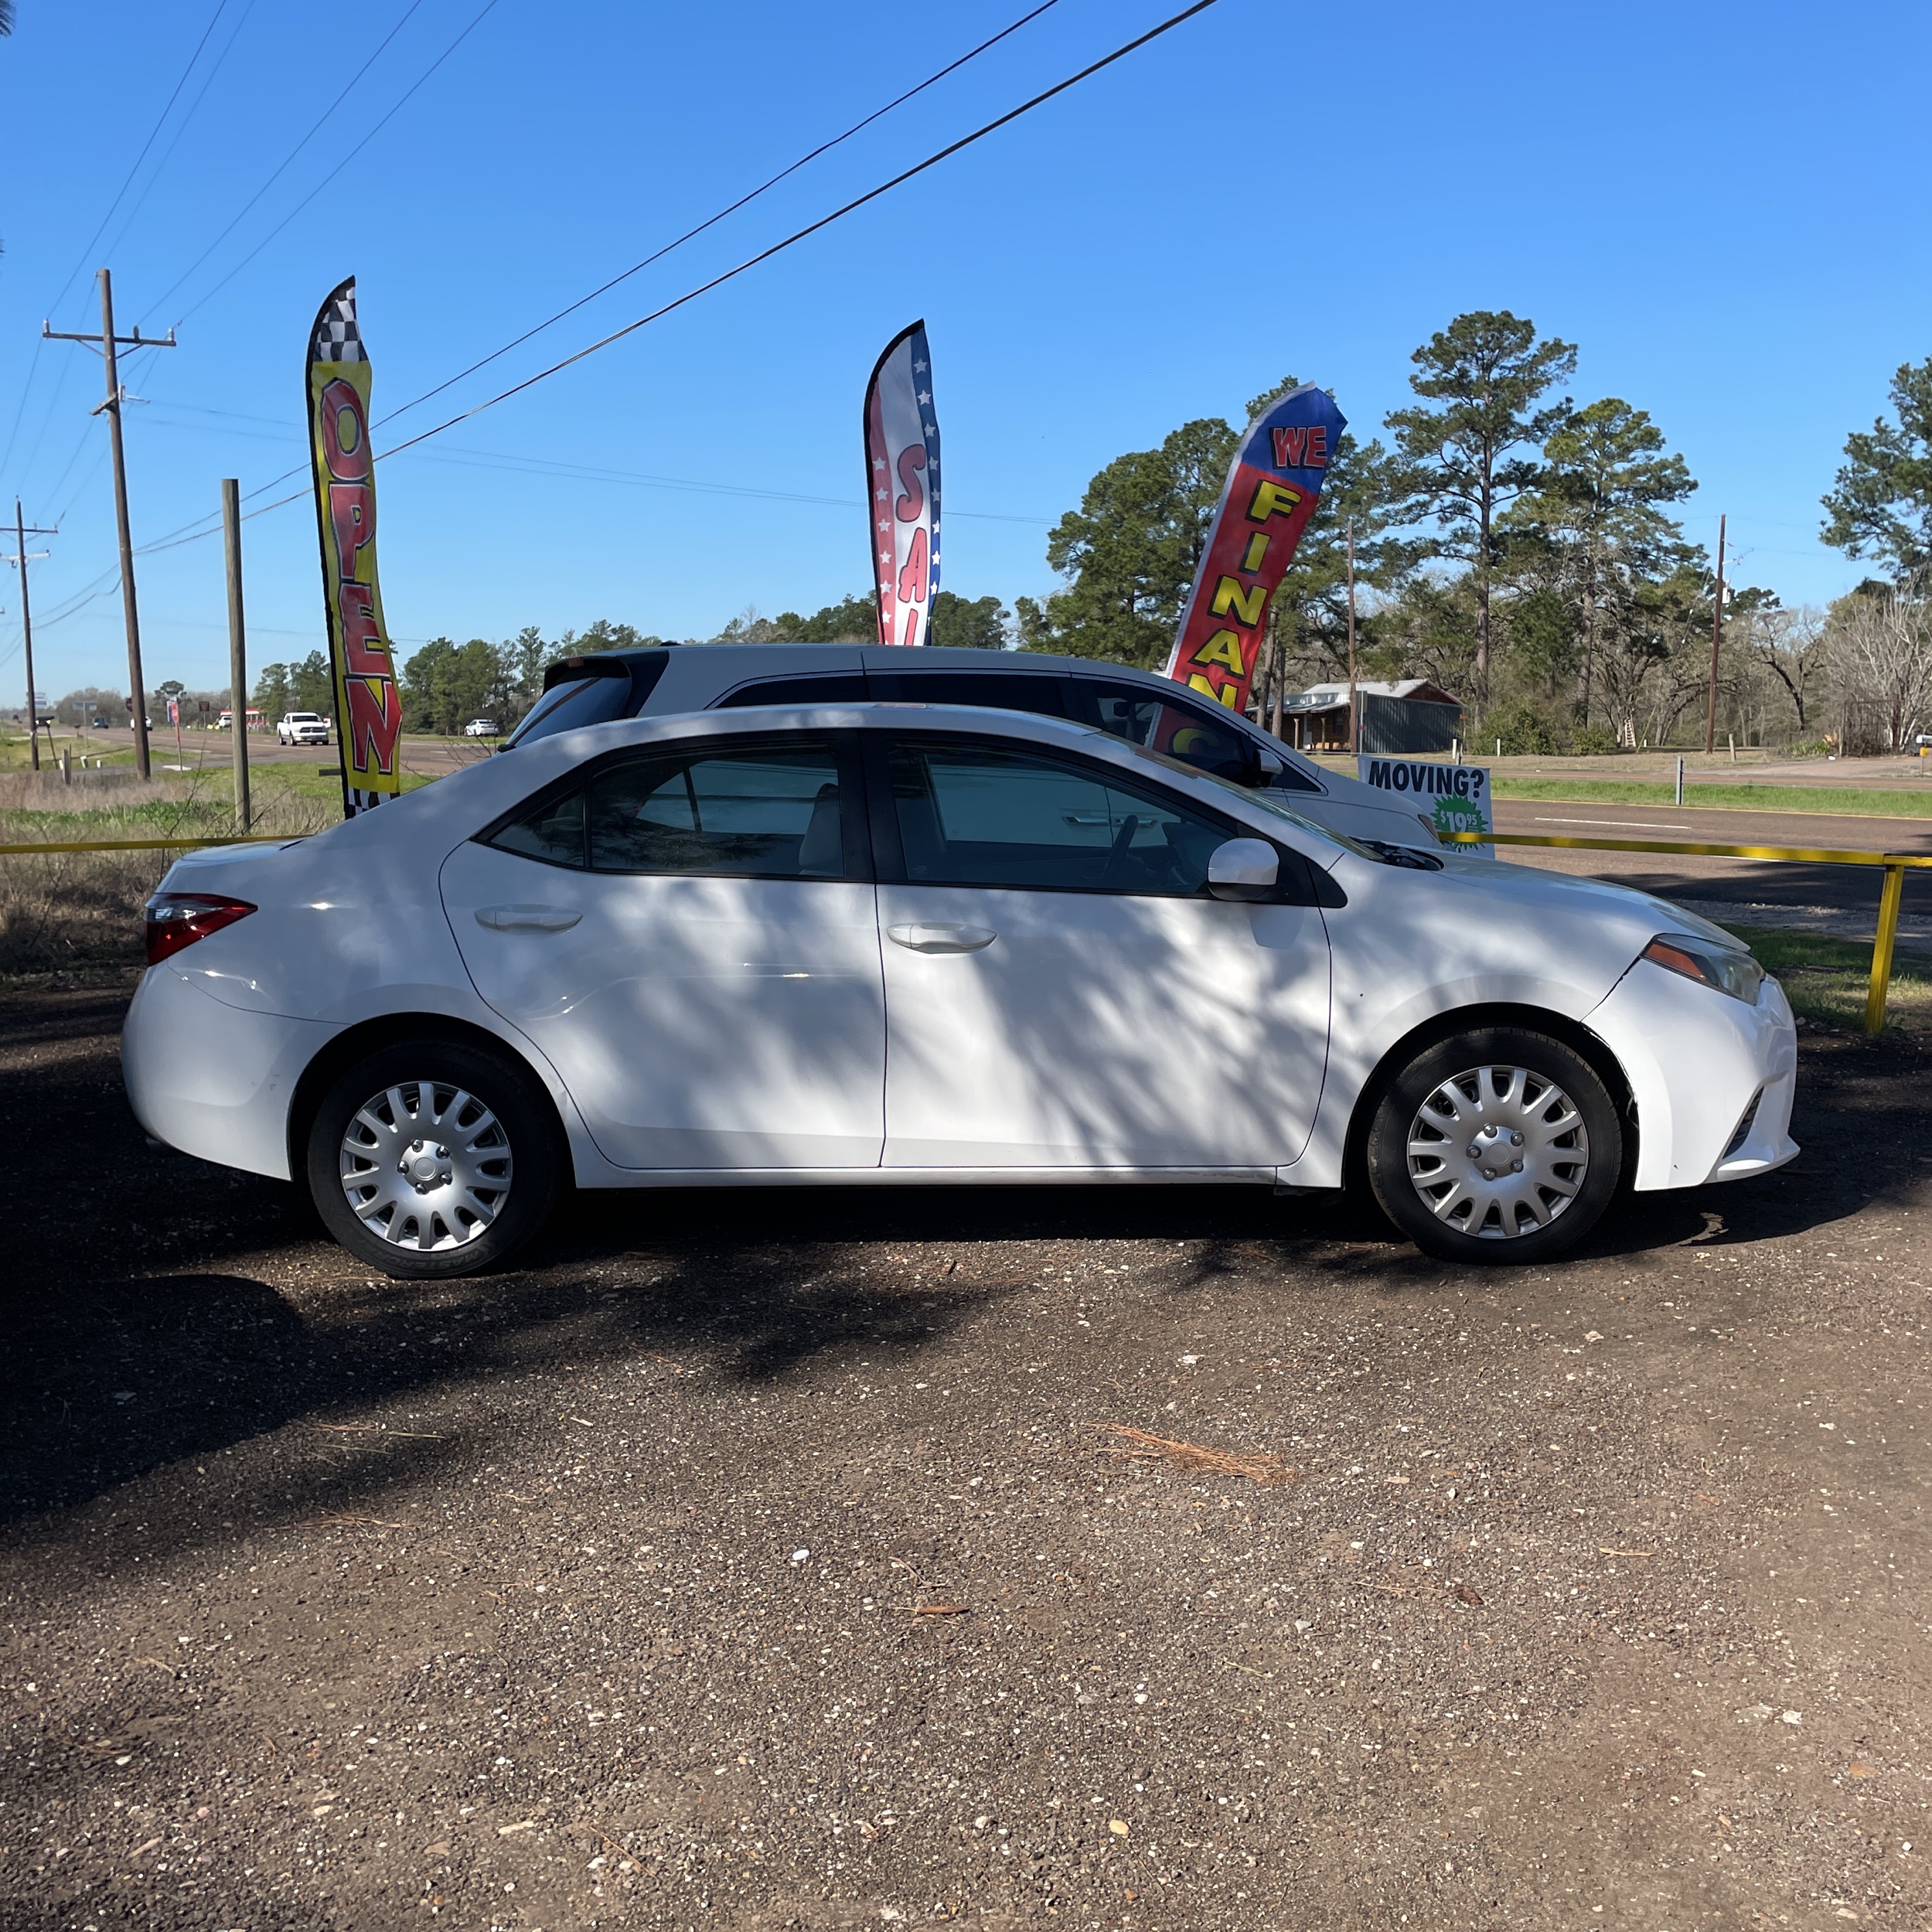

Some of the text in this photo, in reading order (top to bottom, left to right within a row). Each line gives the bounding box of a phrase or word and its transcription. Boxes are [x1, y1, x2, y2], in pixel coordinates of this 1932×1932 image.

[1269, 425, 1327, 469] WE
[321, 377, 402, 774] OPEN
[1368, 761, 1484, 799] MOVING?
